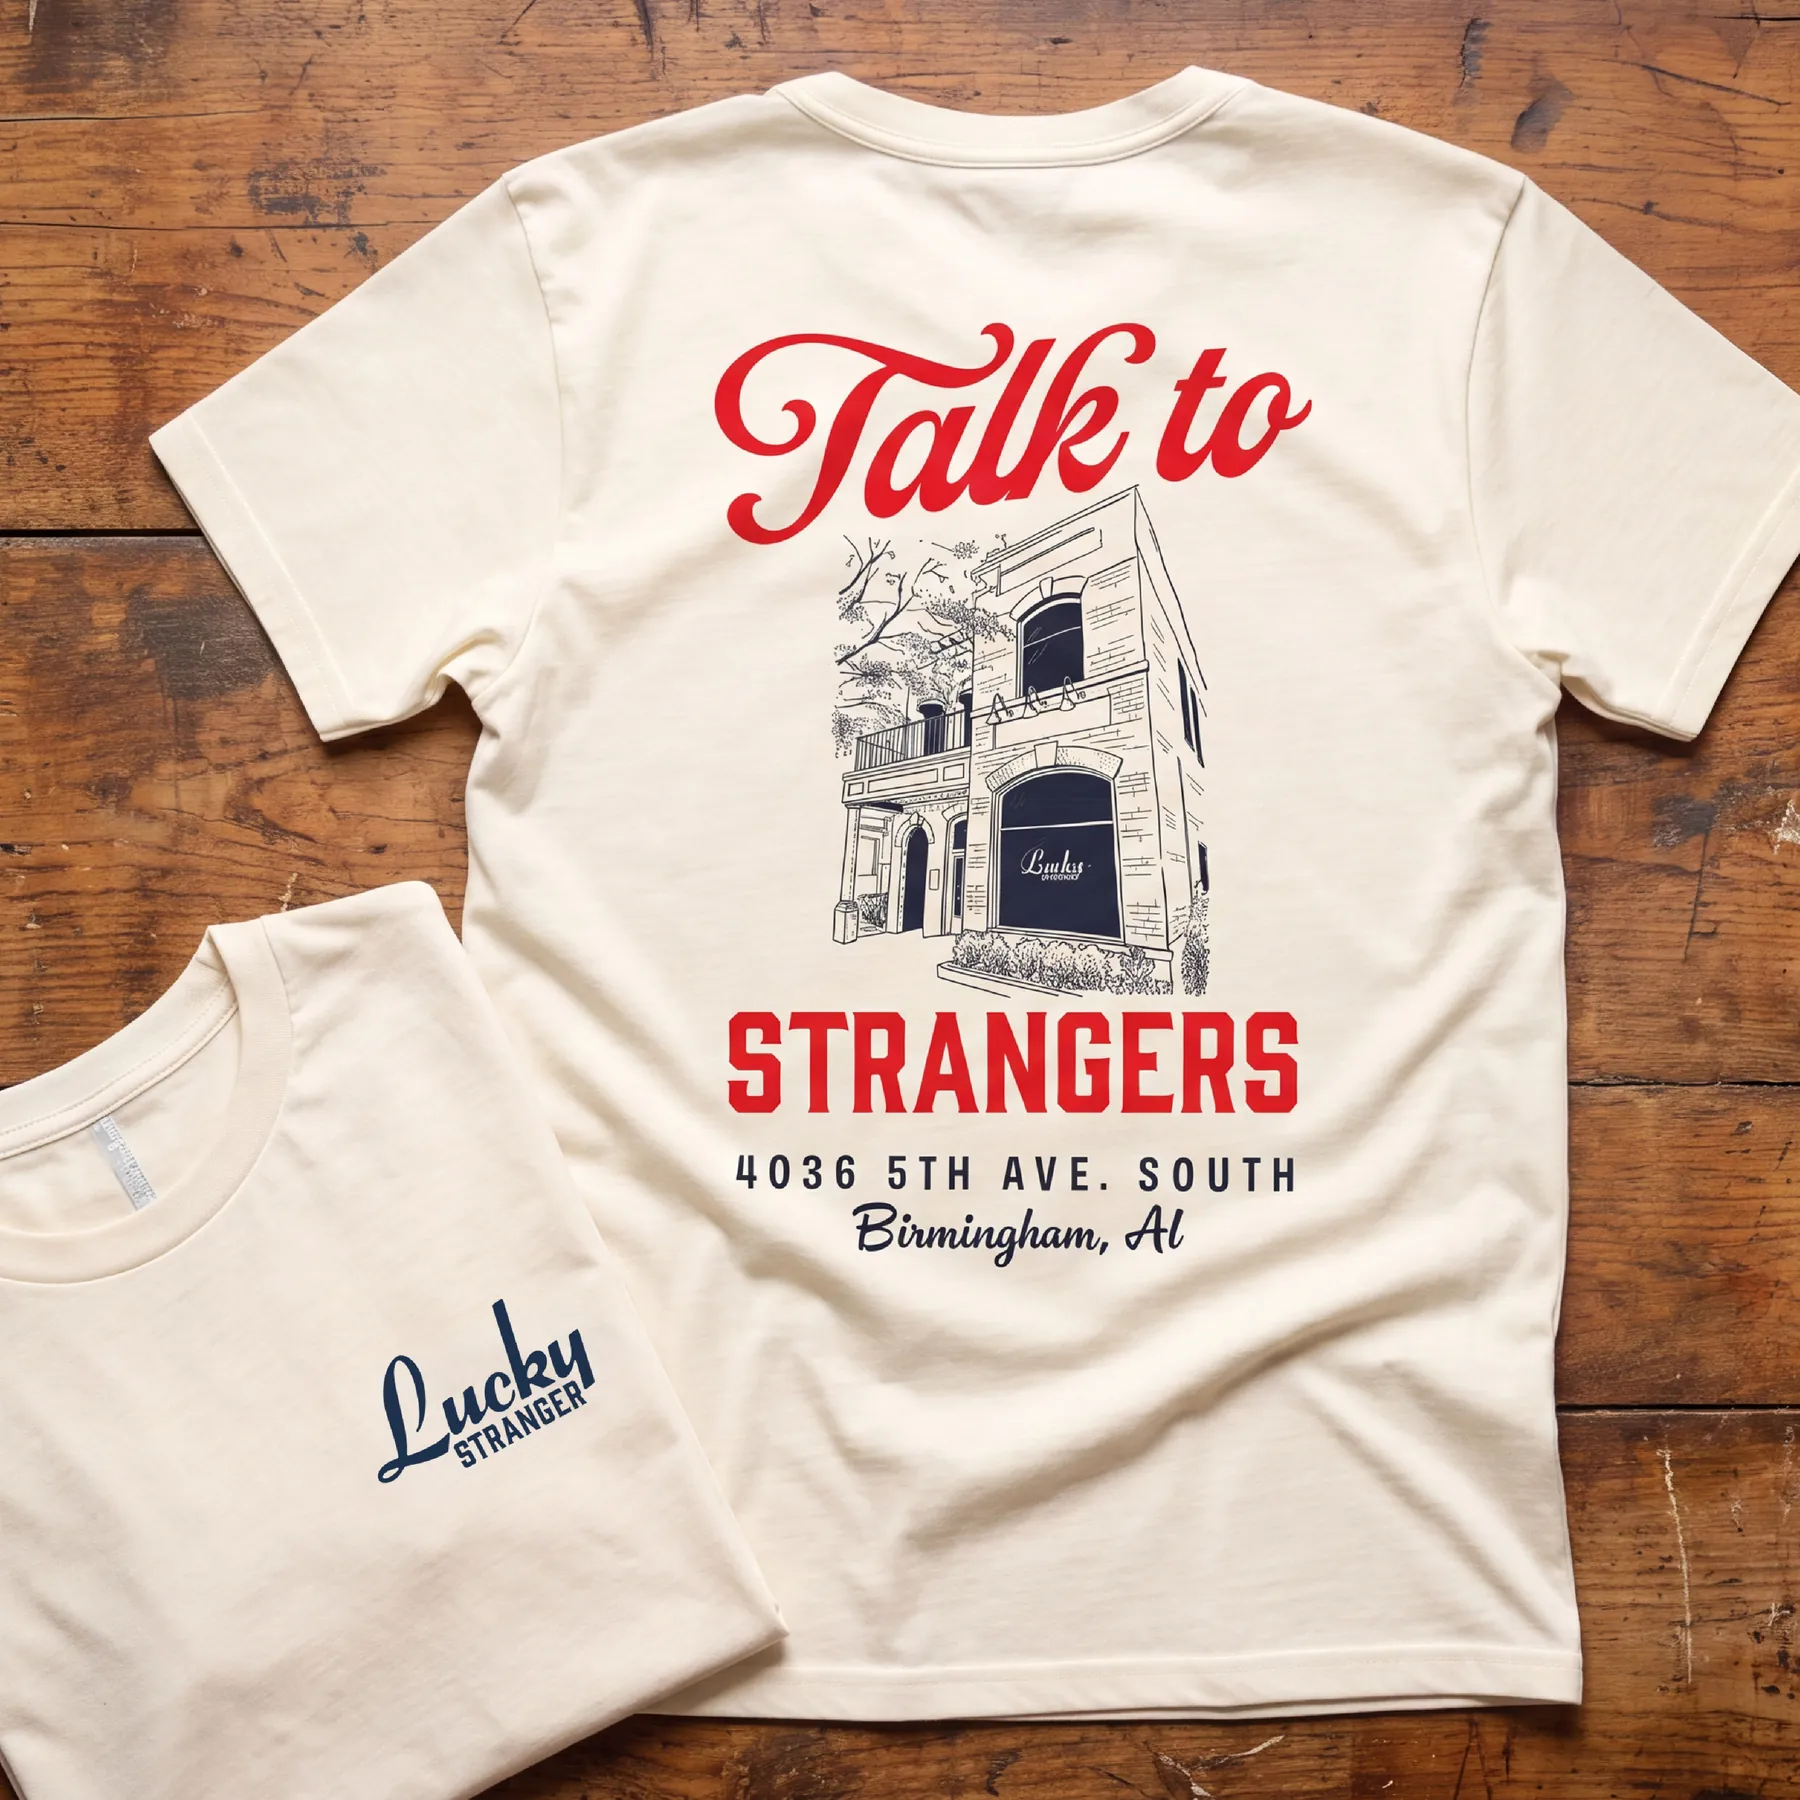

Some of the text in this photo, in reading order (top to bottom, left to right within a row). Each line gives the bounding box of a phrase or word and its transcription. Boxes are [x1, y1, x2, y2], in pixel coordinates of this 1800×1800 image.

[714, 322, 1313, 545] Talk to
[727, 1011, 1299, 1113] STRANGERS
[736, 1154, 1296, 1193] 4036 5TH AVE. SOUTH
[852, 1202, 1185, 1267] Birmingham, Al
[377, 1298, 596, 1484] Lucky
[453, 1380, 588, 1468] STRANGER
